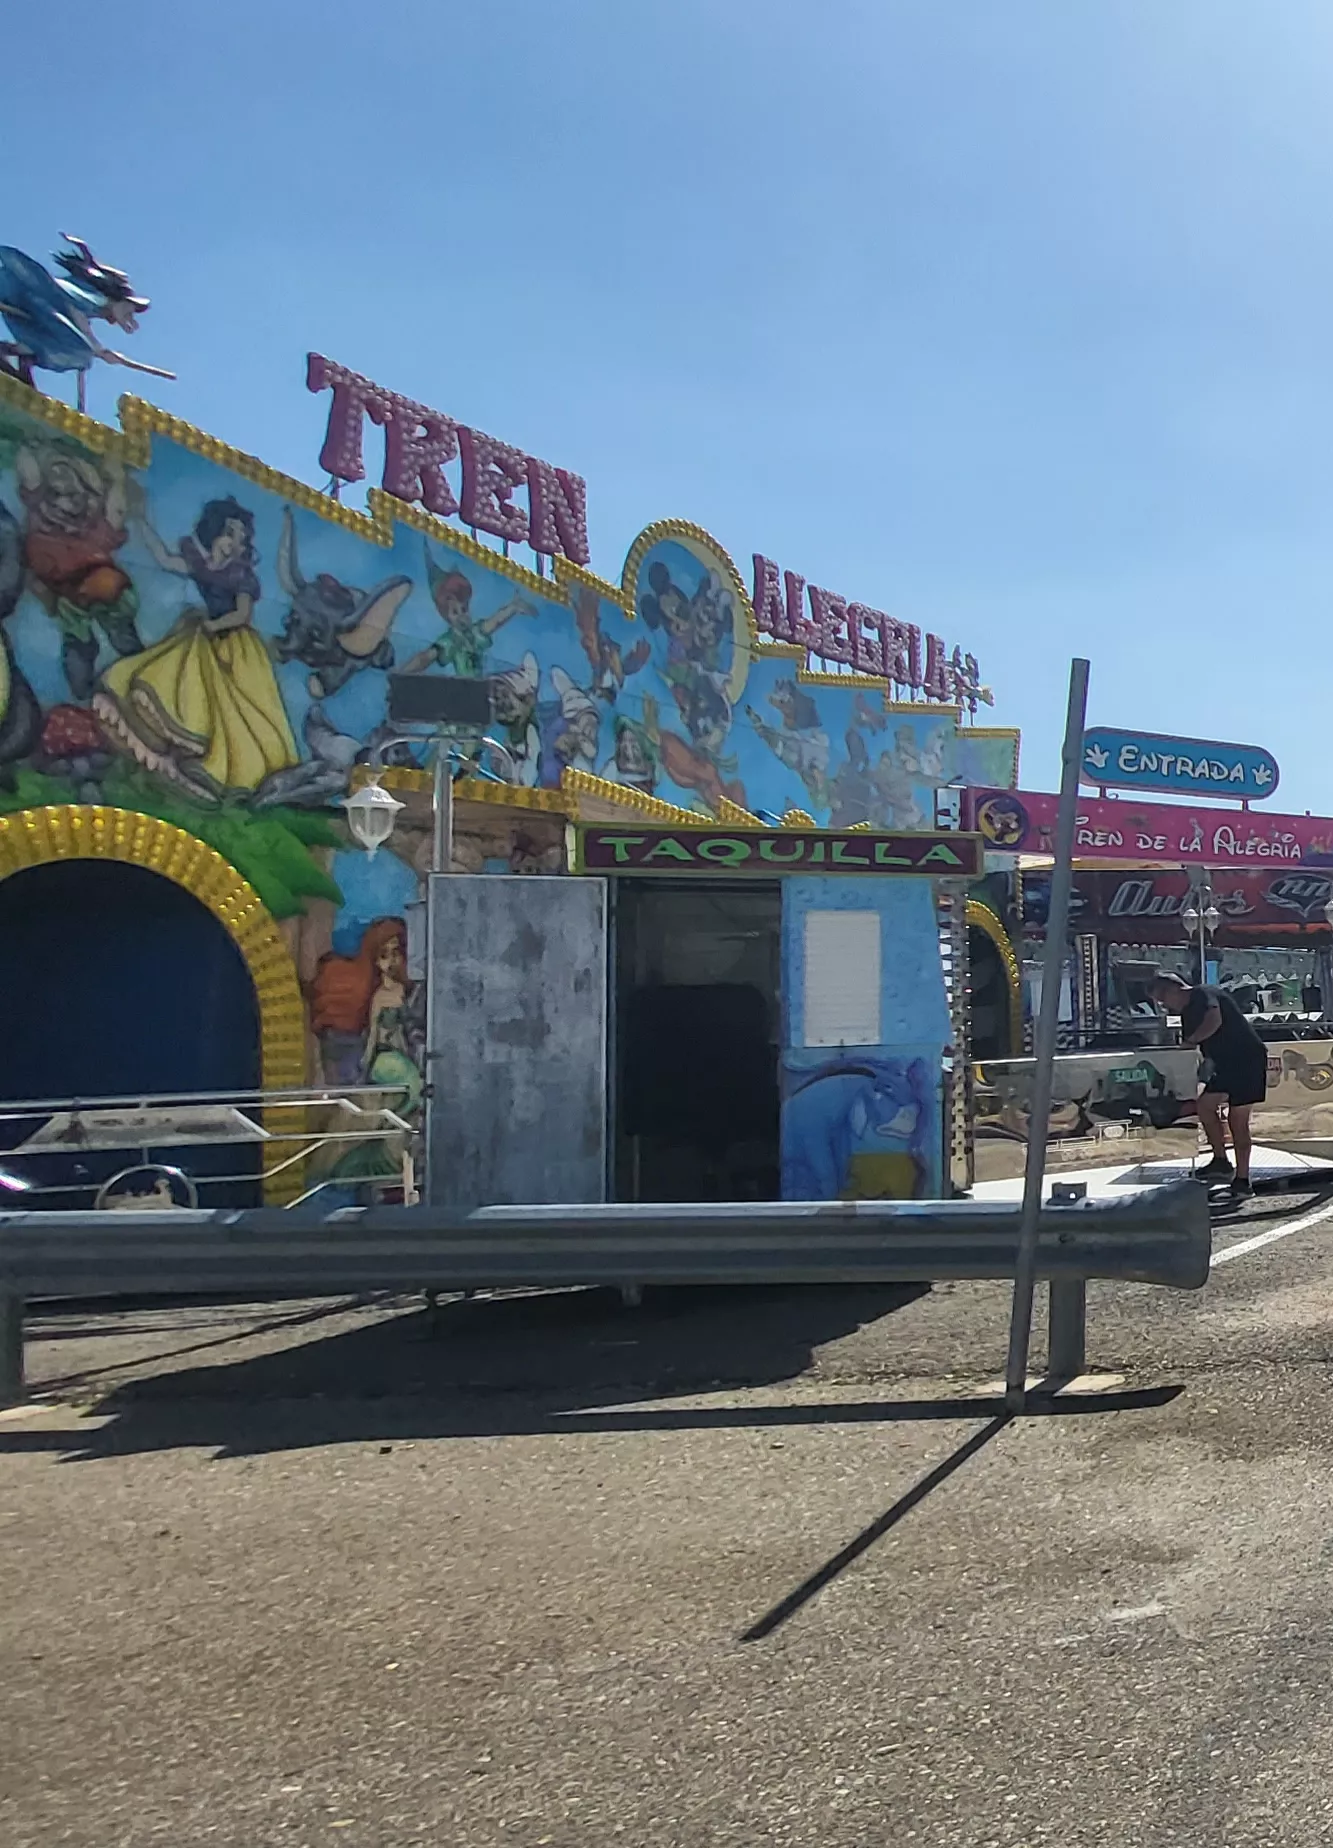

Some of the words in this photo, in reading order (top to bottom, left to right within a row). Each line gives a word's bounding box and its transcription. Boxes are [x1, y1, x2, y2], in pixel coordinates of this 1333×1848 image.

[306, 352, 590, 566] TREN
[752, 553, 953, 700] ALEGRIA
[1117, 744, 1245, 782] ENTRADA
[597, 836, 963, 867] TAQUILLA
[1075, 816, 1123, 847] REN
[1136, 833, 1167, 850] DE
[1180, 836, 1202, 852] LA
